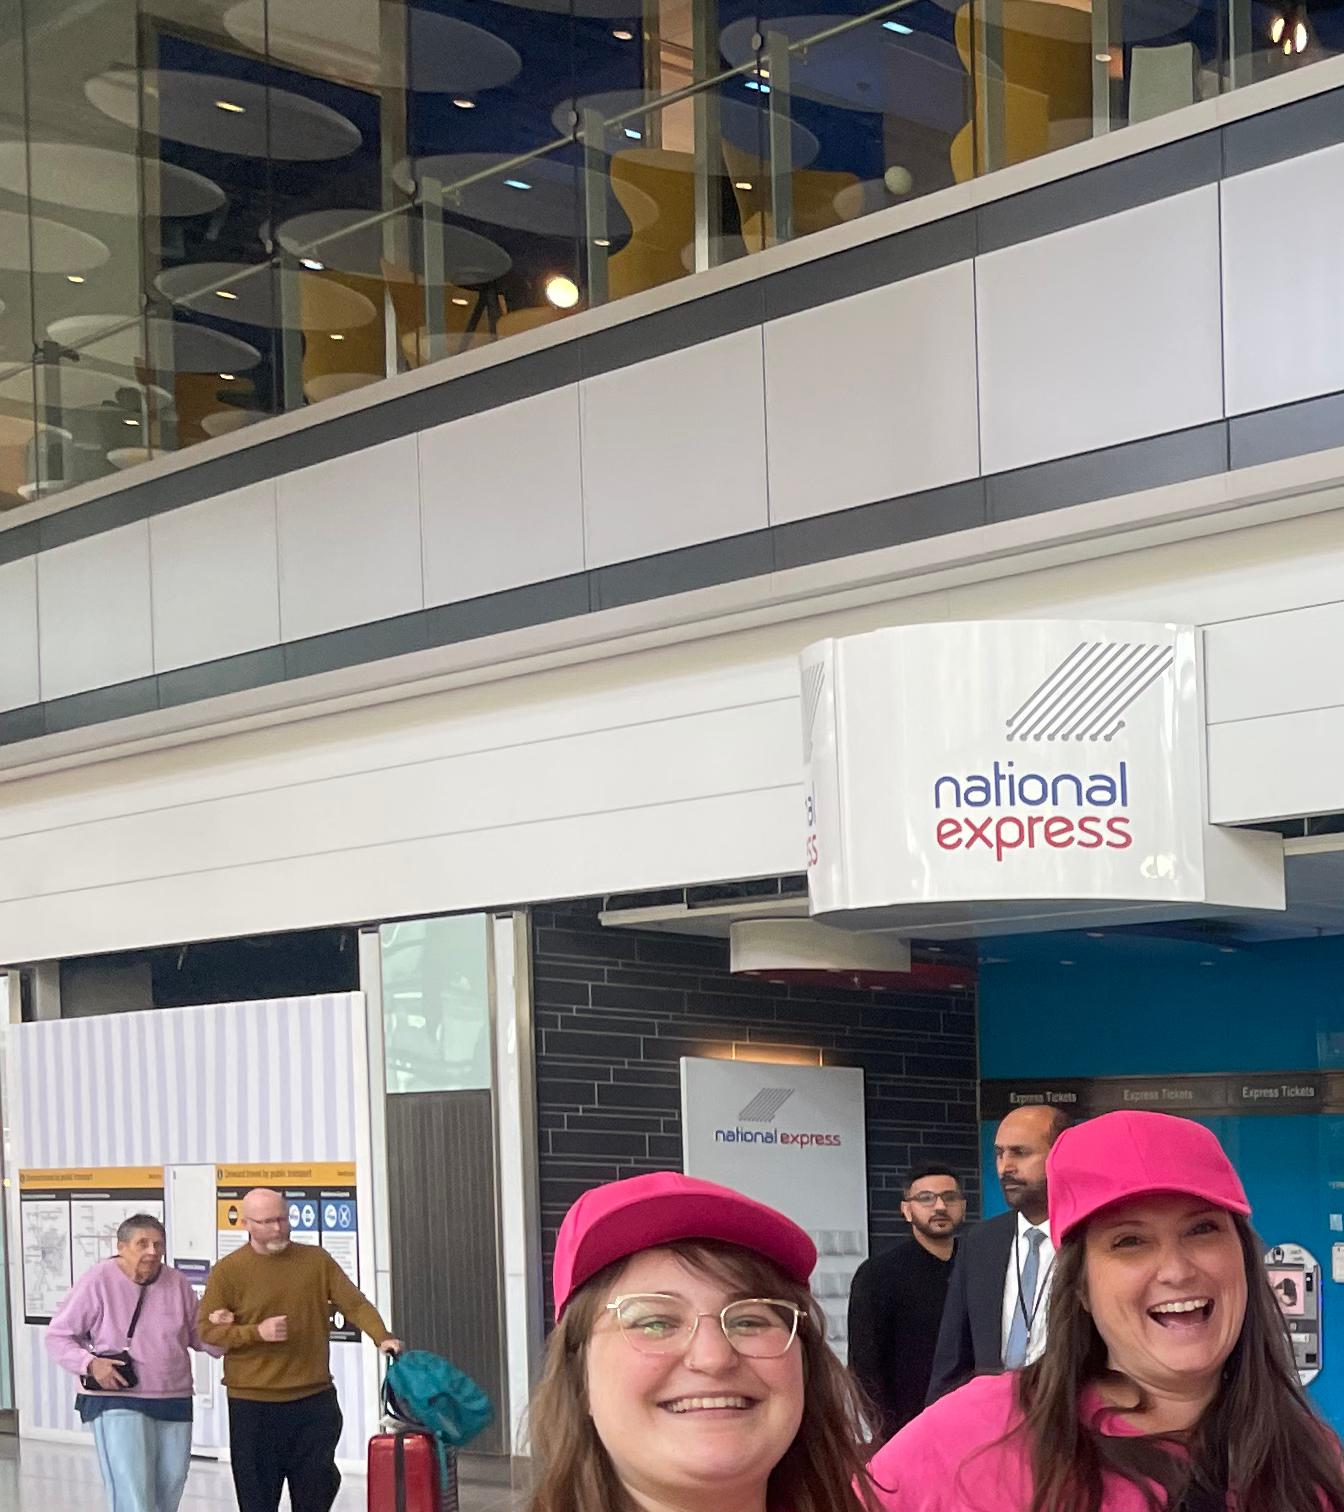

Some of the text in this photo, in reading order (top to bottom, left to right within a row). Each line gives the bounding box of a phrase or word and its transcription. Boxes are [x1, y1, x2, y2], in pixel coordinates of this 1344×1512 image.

[934, 761, 1128, 808] national
[937, 816, 1133, 862] express
[1009, 1091, 1077, 1105] Express Tickets
[1123, 1088, 1193, 1102] Express Tickets
[1242, 1085, 1315, 1100] Express Tickets
[715, 1126, 842, 1149] national express
